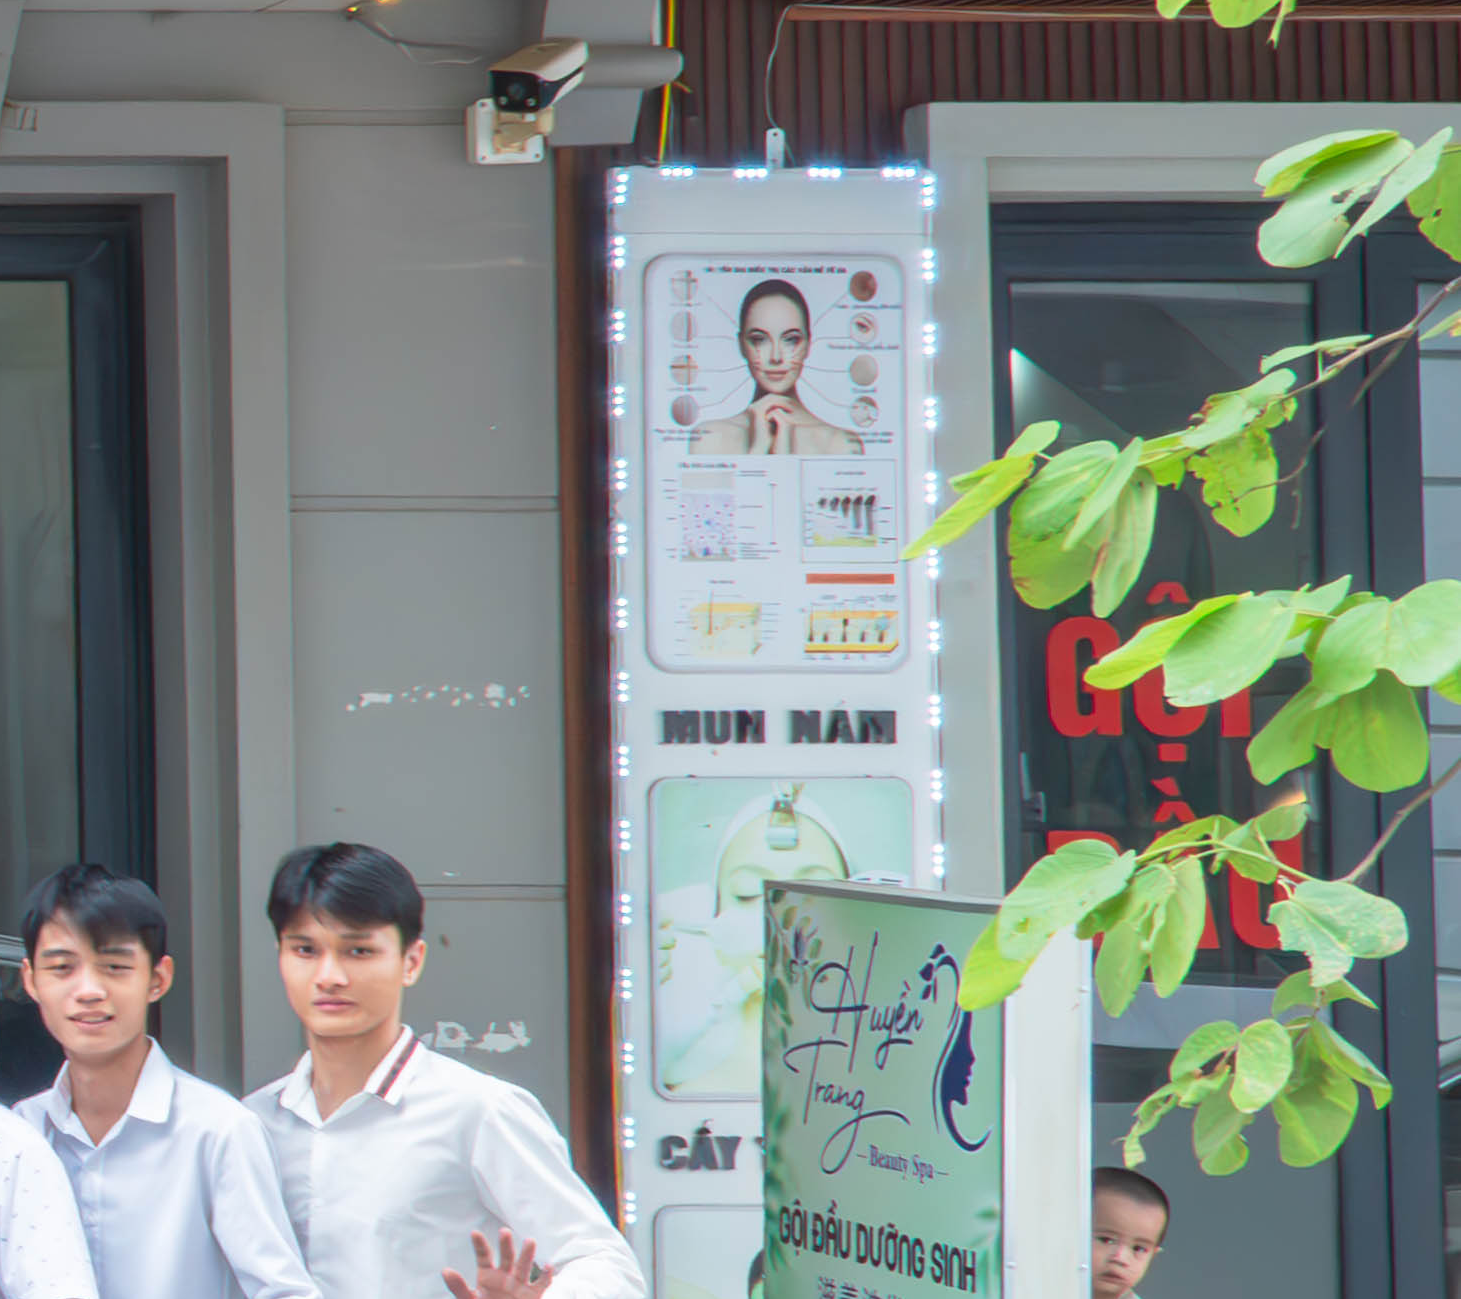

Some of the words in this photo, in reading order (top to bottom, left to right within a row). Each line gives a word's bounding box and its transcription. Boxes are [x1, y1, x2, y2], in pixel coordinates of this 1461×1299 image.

[658, 709, 766, 757] MỤN
[809, 929, 924, 1074] Huyền
[783, 1035, 911, 1175] Trang
[869, 1144, 909, 1180] Beauty
[912, 1154, 934, 1184] Spa
[779, 1198, 808, 1257] GỘI
[811, 1198, 851, 1260] ĐẦU
[856, 1222, 925, 1279] DƯỠNG
[931, 1241, 977, 1293] SINH
